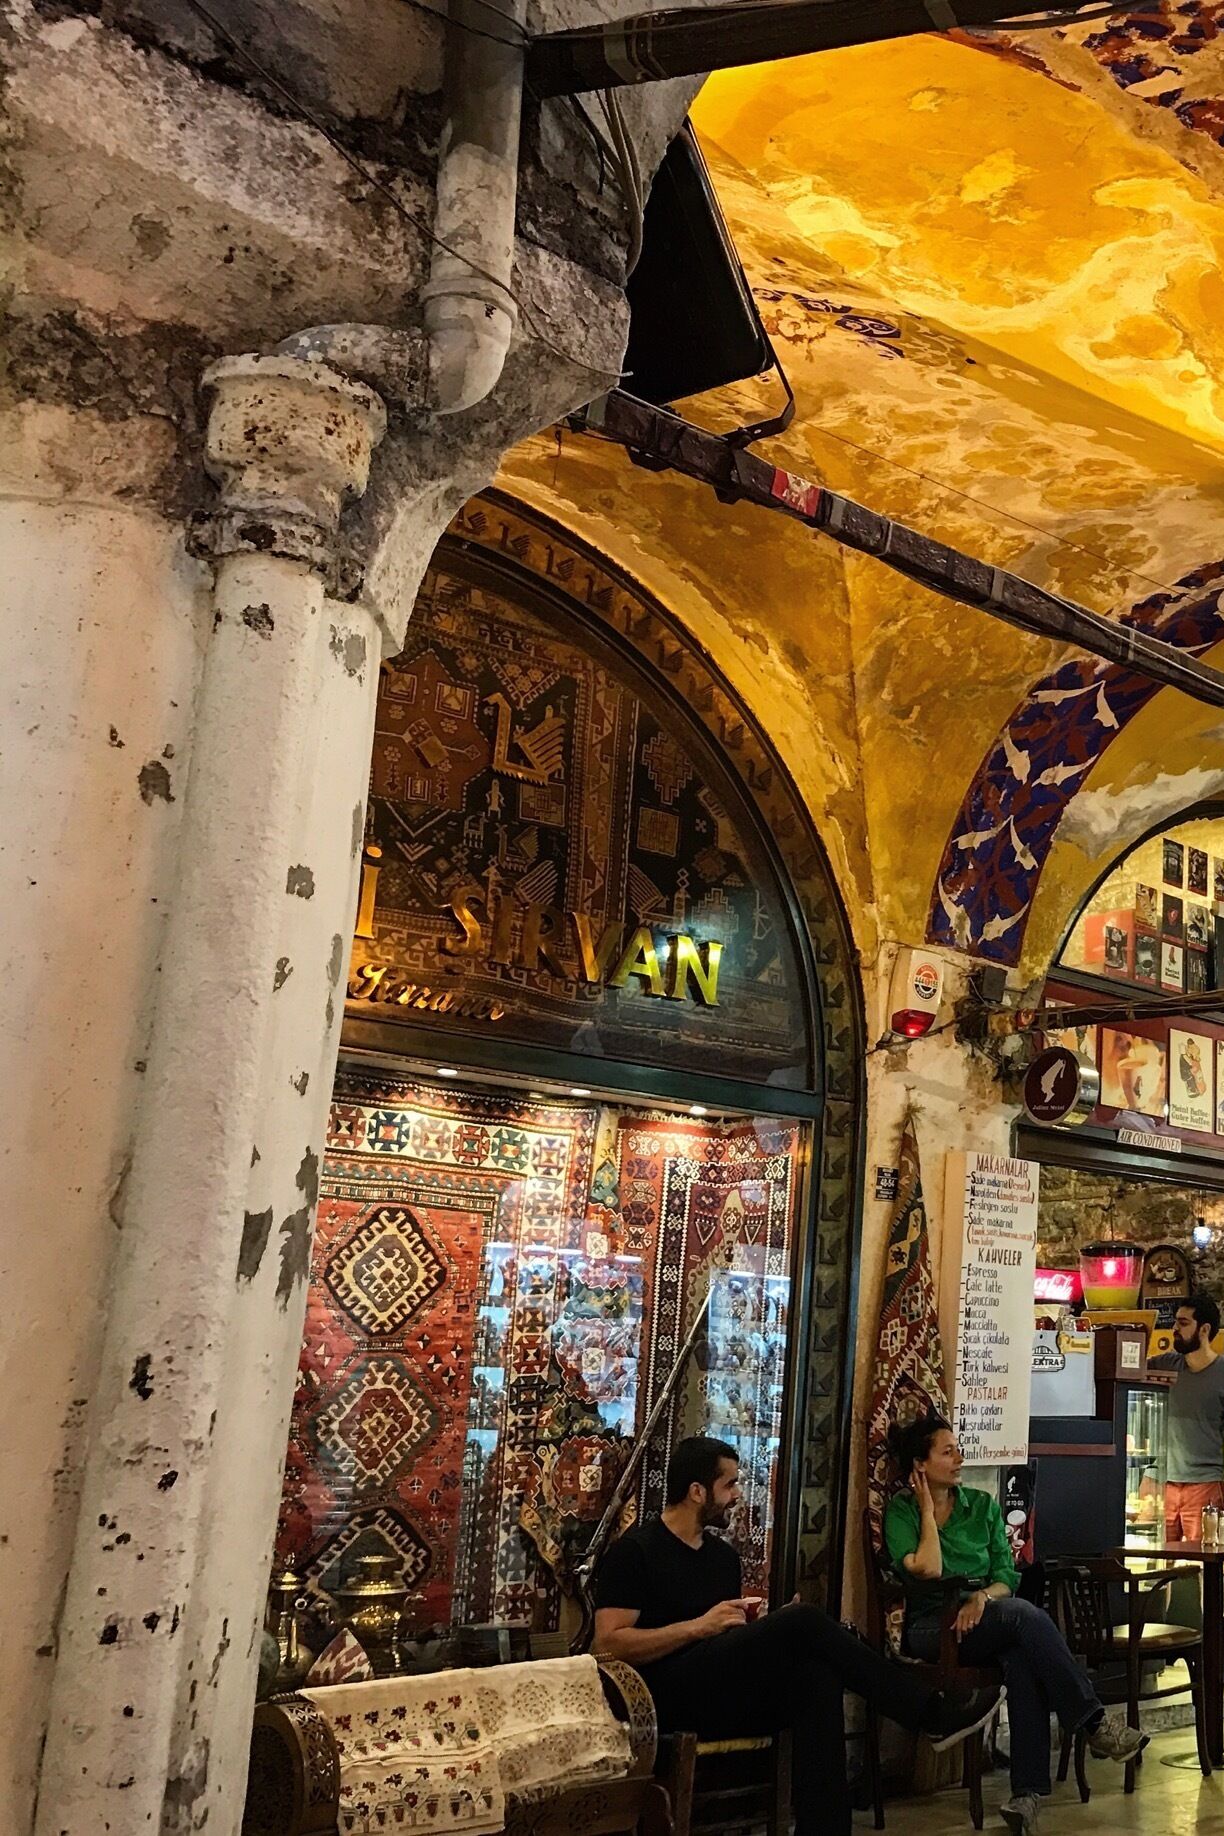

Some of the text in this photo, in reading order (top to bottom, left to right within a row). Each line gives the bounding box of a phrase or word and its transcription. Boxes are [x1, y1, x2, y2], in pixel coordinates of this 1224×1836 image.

[1120, 1130, 1132, 1142] AIR
[976, 1154, 1029, 1179] MAKARNALAR
[1001, 1203, 1018, 1214] soslu
[978, 1248, 1022, 1266] KAHVELER
[985, 1280, 1003, 1293] latte
[983, 1360, 1008, 1373] kahvesi
[968, 1387, 1008, 1400] PASTALAR
